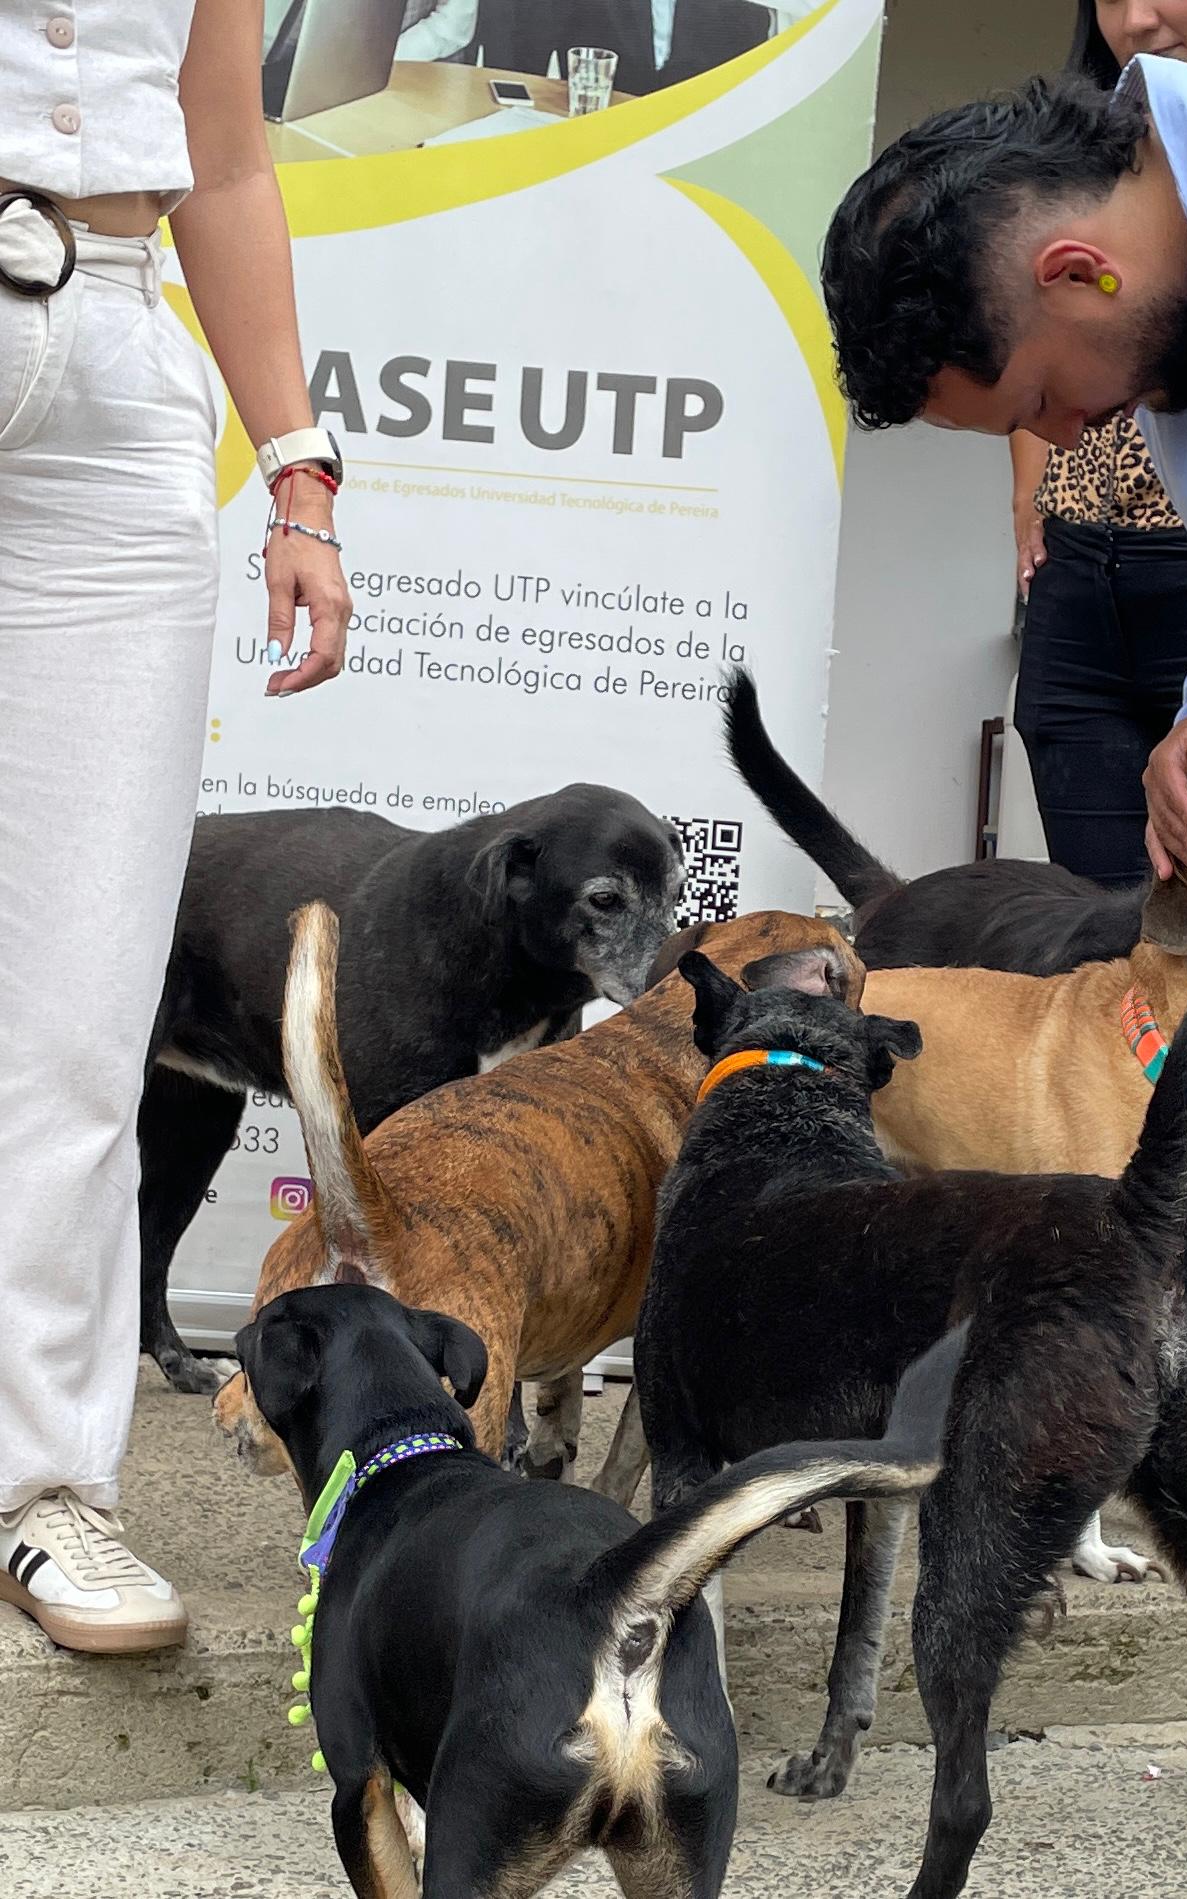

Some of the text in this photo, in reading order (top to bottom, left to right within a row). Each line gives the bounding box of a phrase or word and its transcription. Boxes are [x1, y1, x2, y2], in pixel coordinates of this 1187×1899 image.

[371, 478, 390, 493] de
[393, 480, 465, 498] Egresados
[470, 486, 556, 506] Universidad
[560, 493, 644, 515] Tecnológica
[648, 500, 667, 515] de
[669, 502, 720, 519] Pereira
[350, 569, 482, 598] egresado
[494, 574, 551, 604] UTP
[561, 583, 685, 616] vincúlate
[695, 599, 712, 617] a
[724, 590, 748, 620] la
[347, 608, 745, 662] ociación de egresados de la
[414, 650, 582, 694] Tecnológica
[593, 665, 628, 694] de
[201, 777, 228, 793] en
[238, 772, 257, 796] la
[266, 774, 377, 806] búsqueda
[386, 784, 414, 808] de
